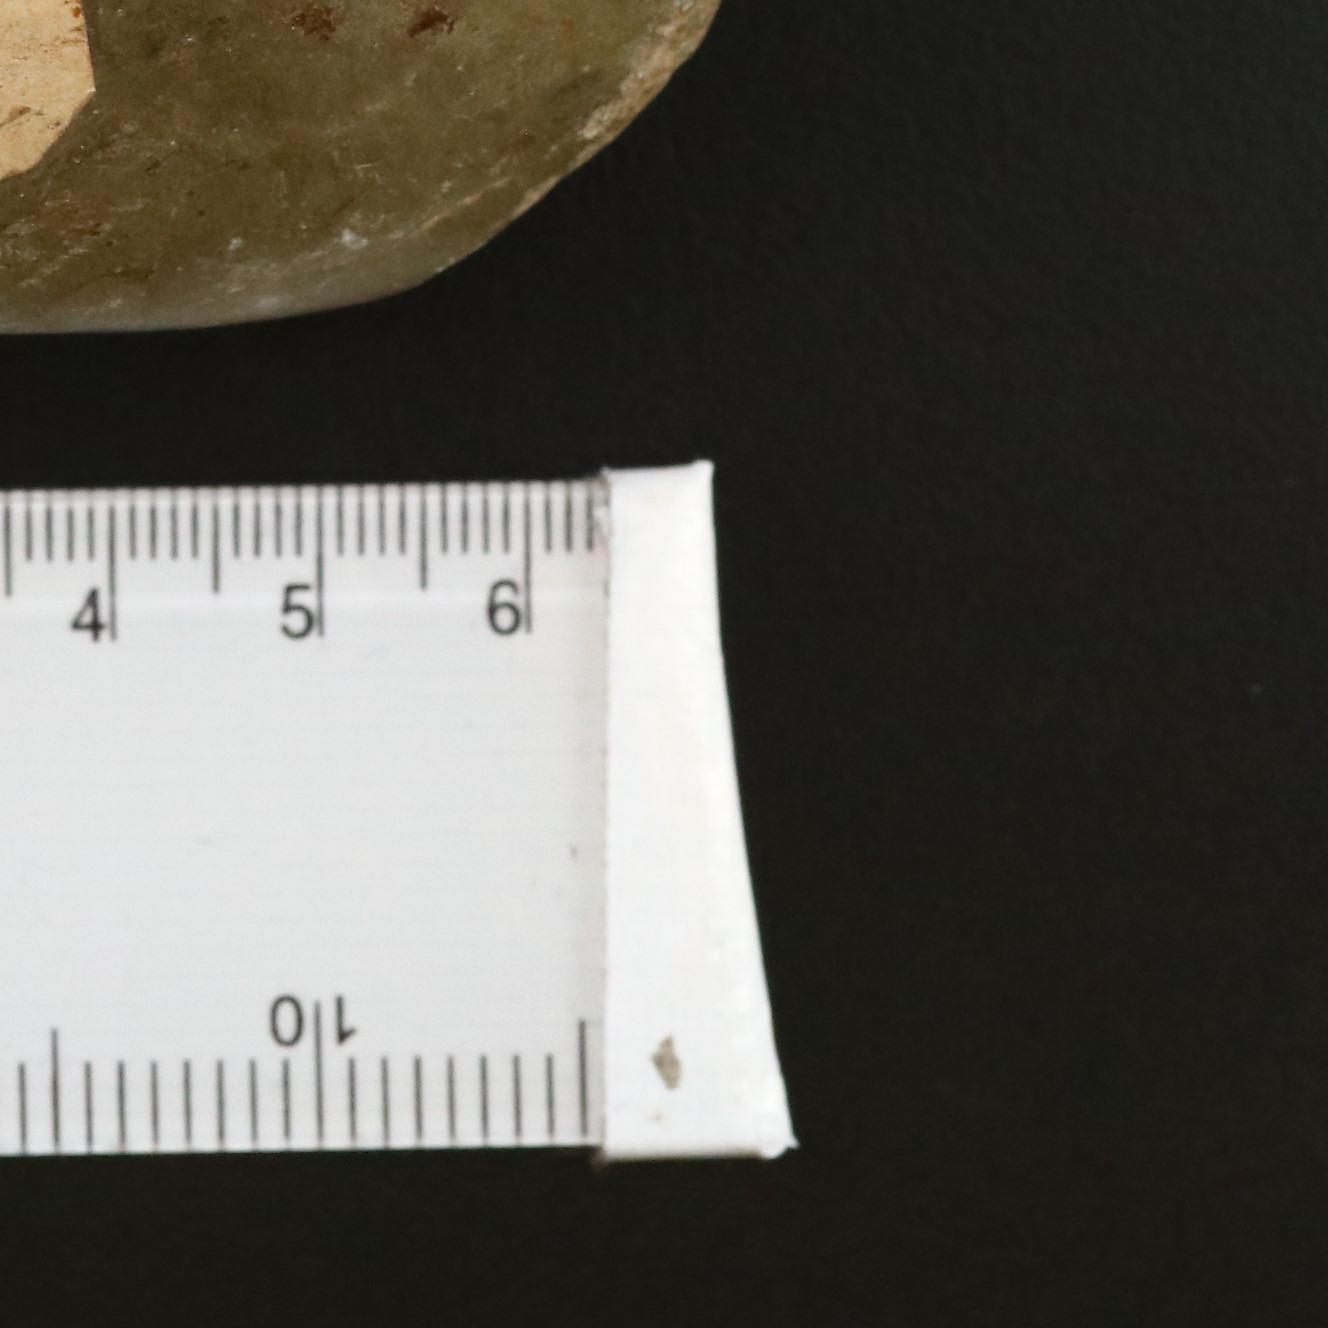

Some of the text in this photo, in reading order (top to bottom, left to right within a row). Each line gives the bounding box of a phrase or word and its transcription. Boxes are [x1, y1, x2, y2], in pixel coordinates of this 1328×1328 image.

[71, 589, 105, 644] 4
[281, 585, 315, 639] 5
[488, 581, 521, 635] 6
[270, 994, 358, 1048] 10
